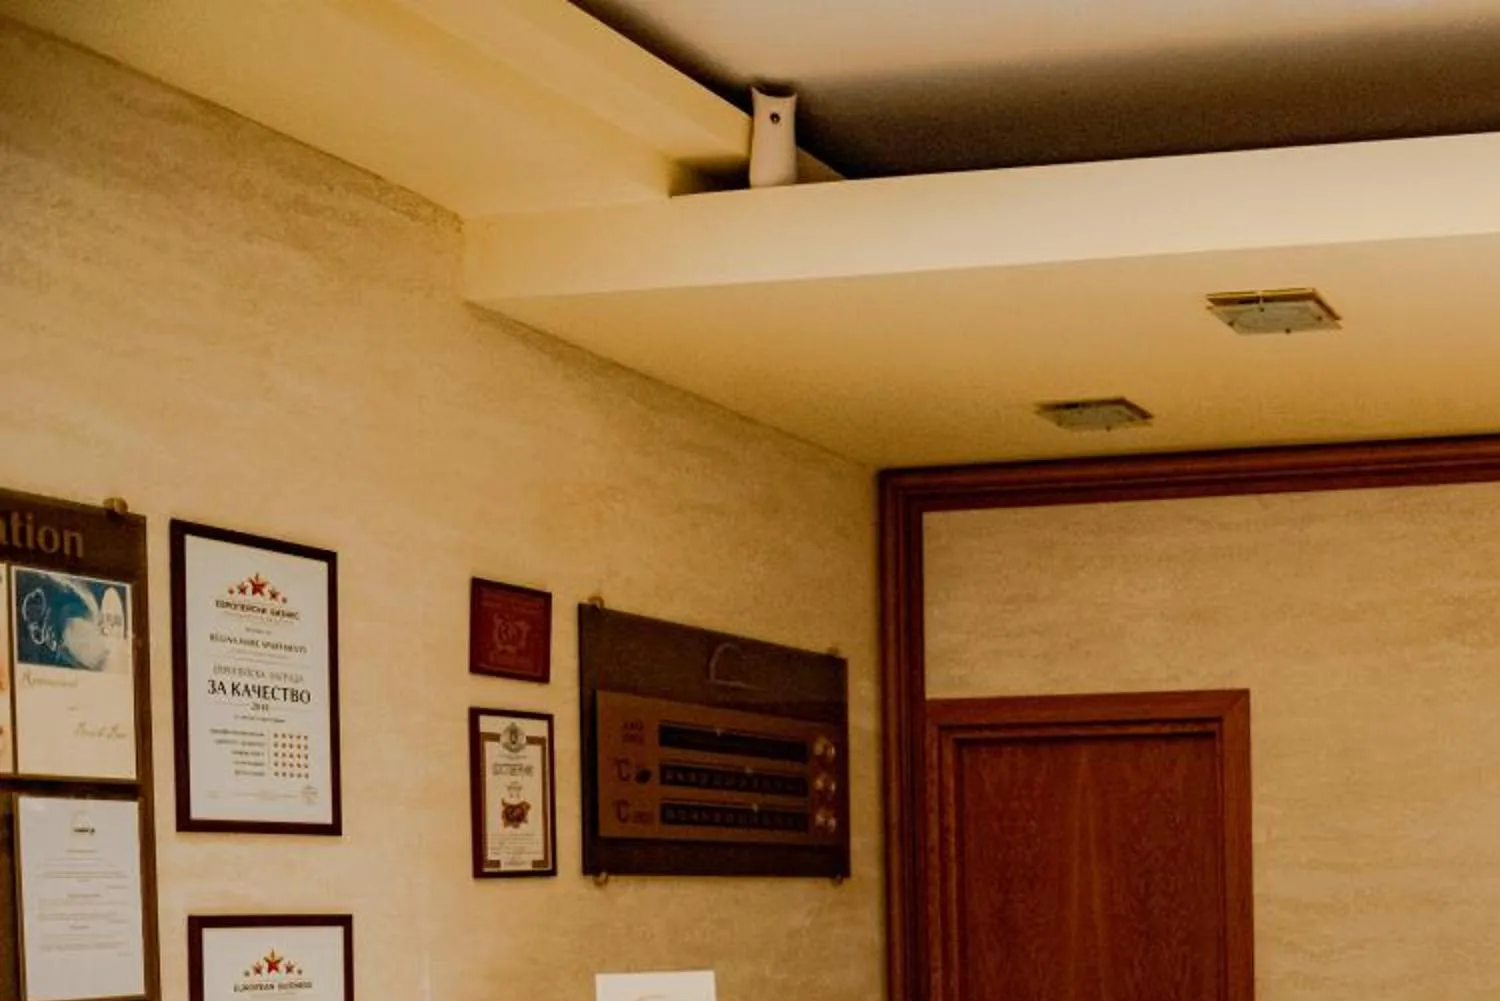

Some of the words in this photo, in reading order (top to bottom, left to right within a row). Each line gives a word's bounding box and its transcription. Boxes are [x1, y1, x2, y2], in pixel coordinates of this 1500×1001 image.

[0, 511, 84, 558] tion
[207, 679, 228, 696] ЗА
[231, 681, 312, 704] КАЧЕСТВО
